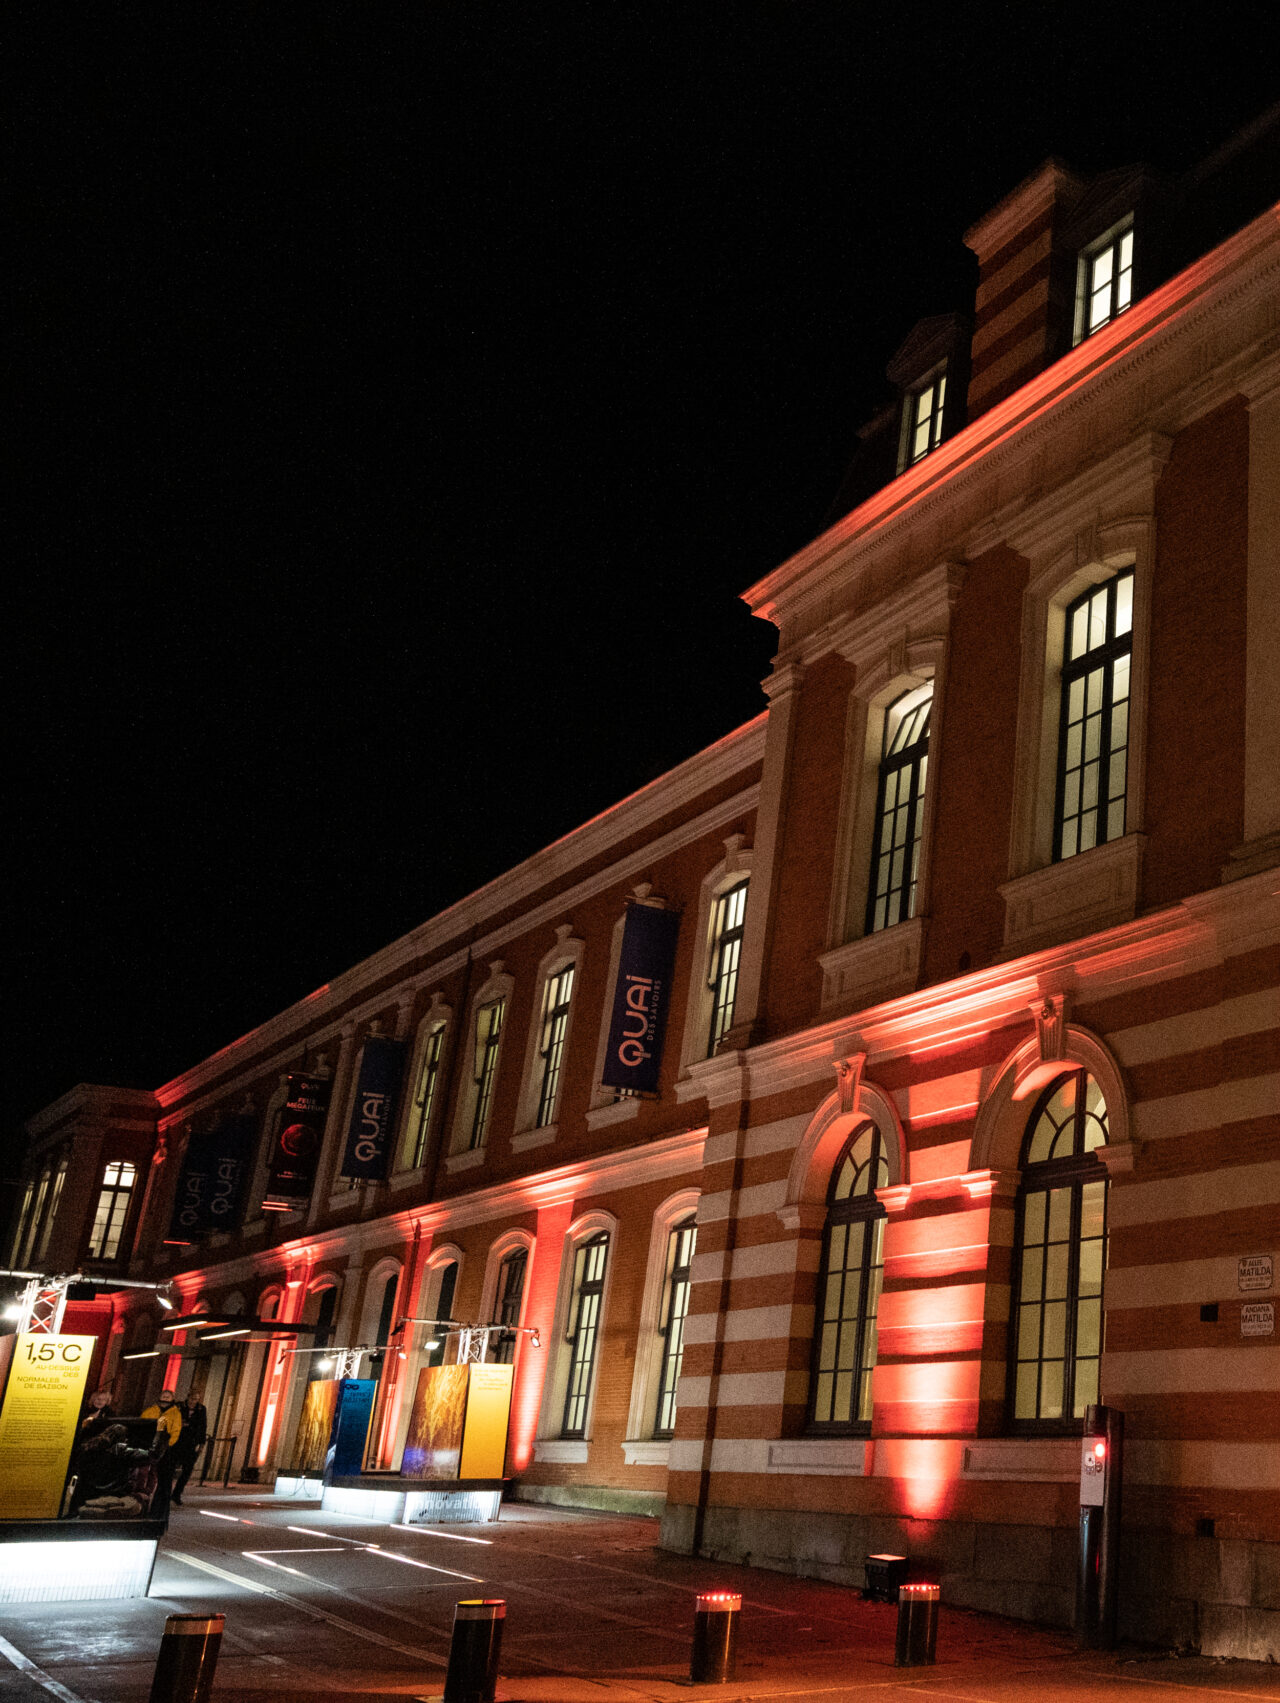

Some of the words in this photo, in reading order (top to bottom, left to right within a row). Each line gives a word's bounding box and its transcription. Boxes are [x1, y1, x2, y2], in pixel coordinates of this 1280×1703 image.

[648, 979, 662, 1020] SAVOIRS
[646, 1023, 656, 1041] DES
[1240, 1266, 1271, 1277] MATILDA
[1241, 1314, 1273, 1323] MATILDA
